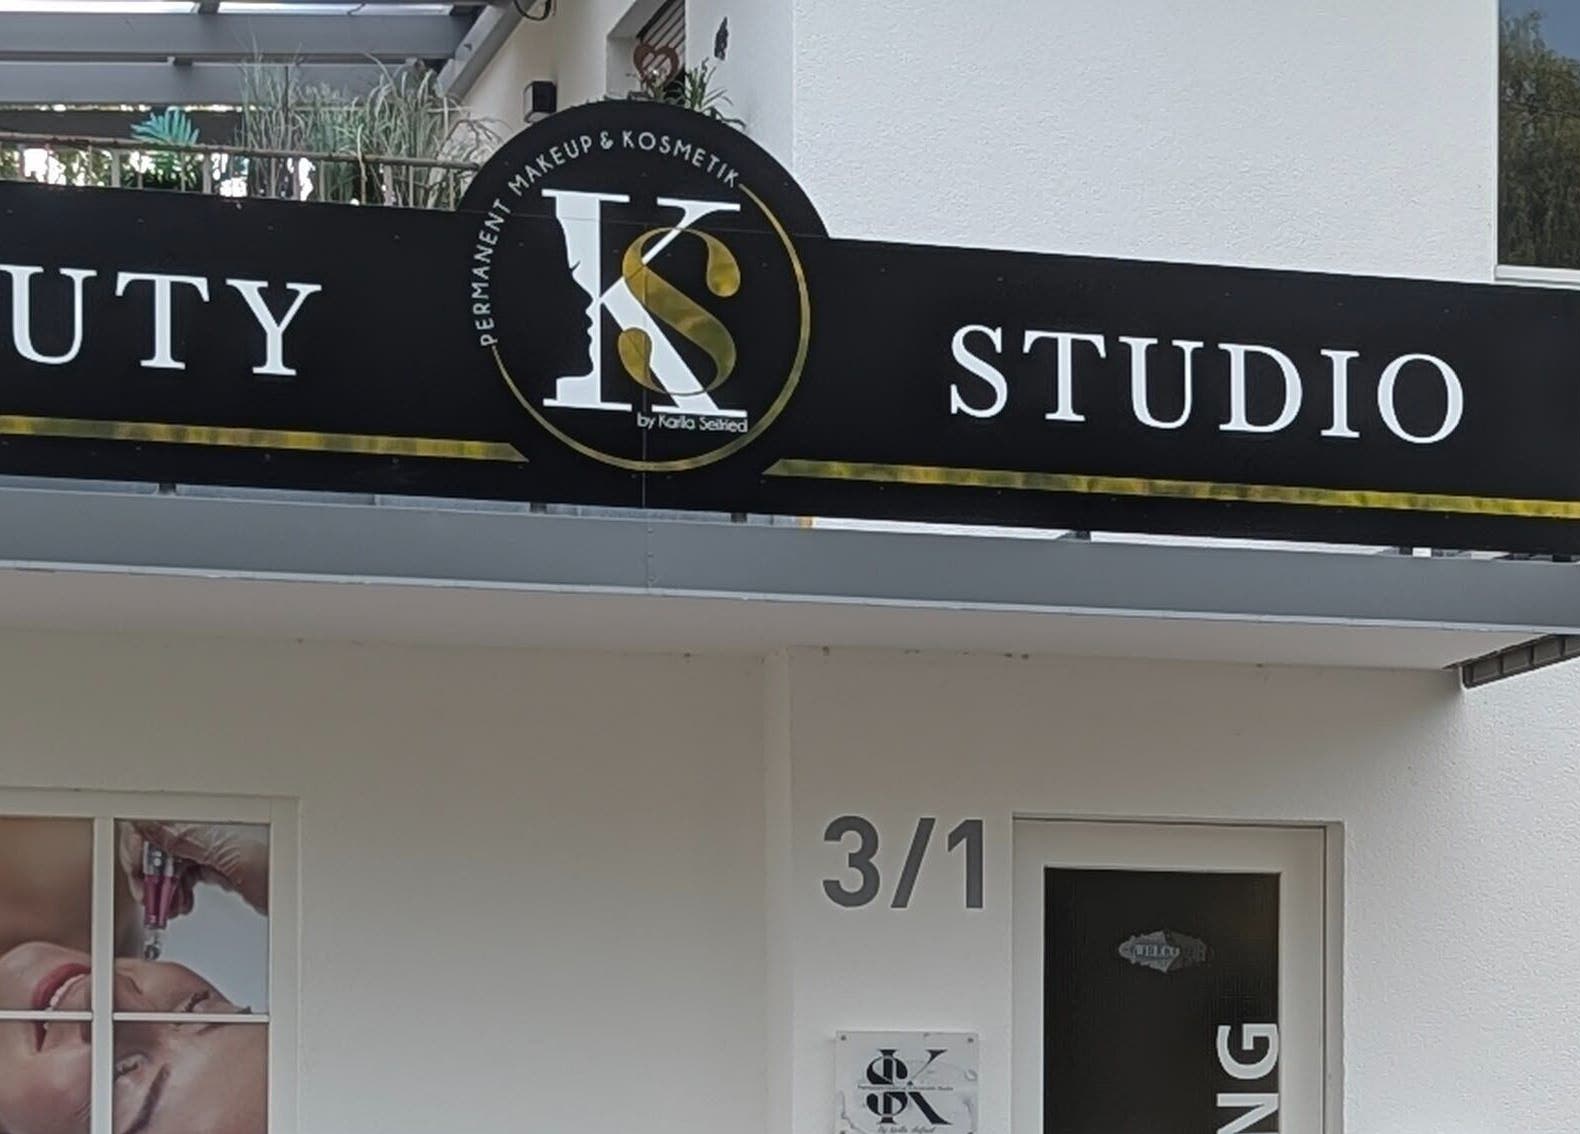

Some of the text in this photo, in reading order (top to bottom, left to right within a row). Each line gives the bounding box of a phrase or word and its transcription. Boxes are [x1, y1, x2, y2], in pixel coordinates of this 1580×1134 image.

[472, 130, 740, 347] PERMANENT MAKEUP & KOSMETIK
[636, 411, 656, 430] by
[950, 323, 1465, 444] STUDIO
[822, 815, 984, 909] 3/1
